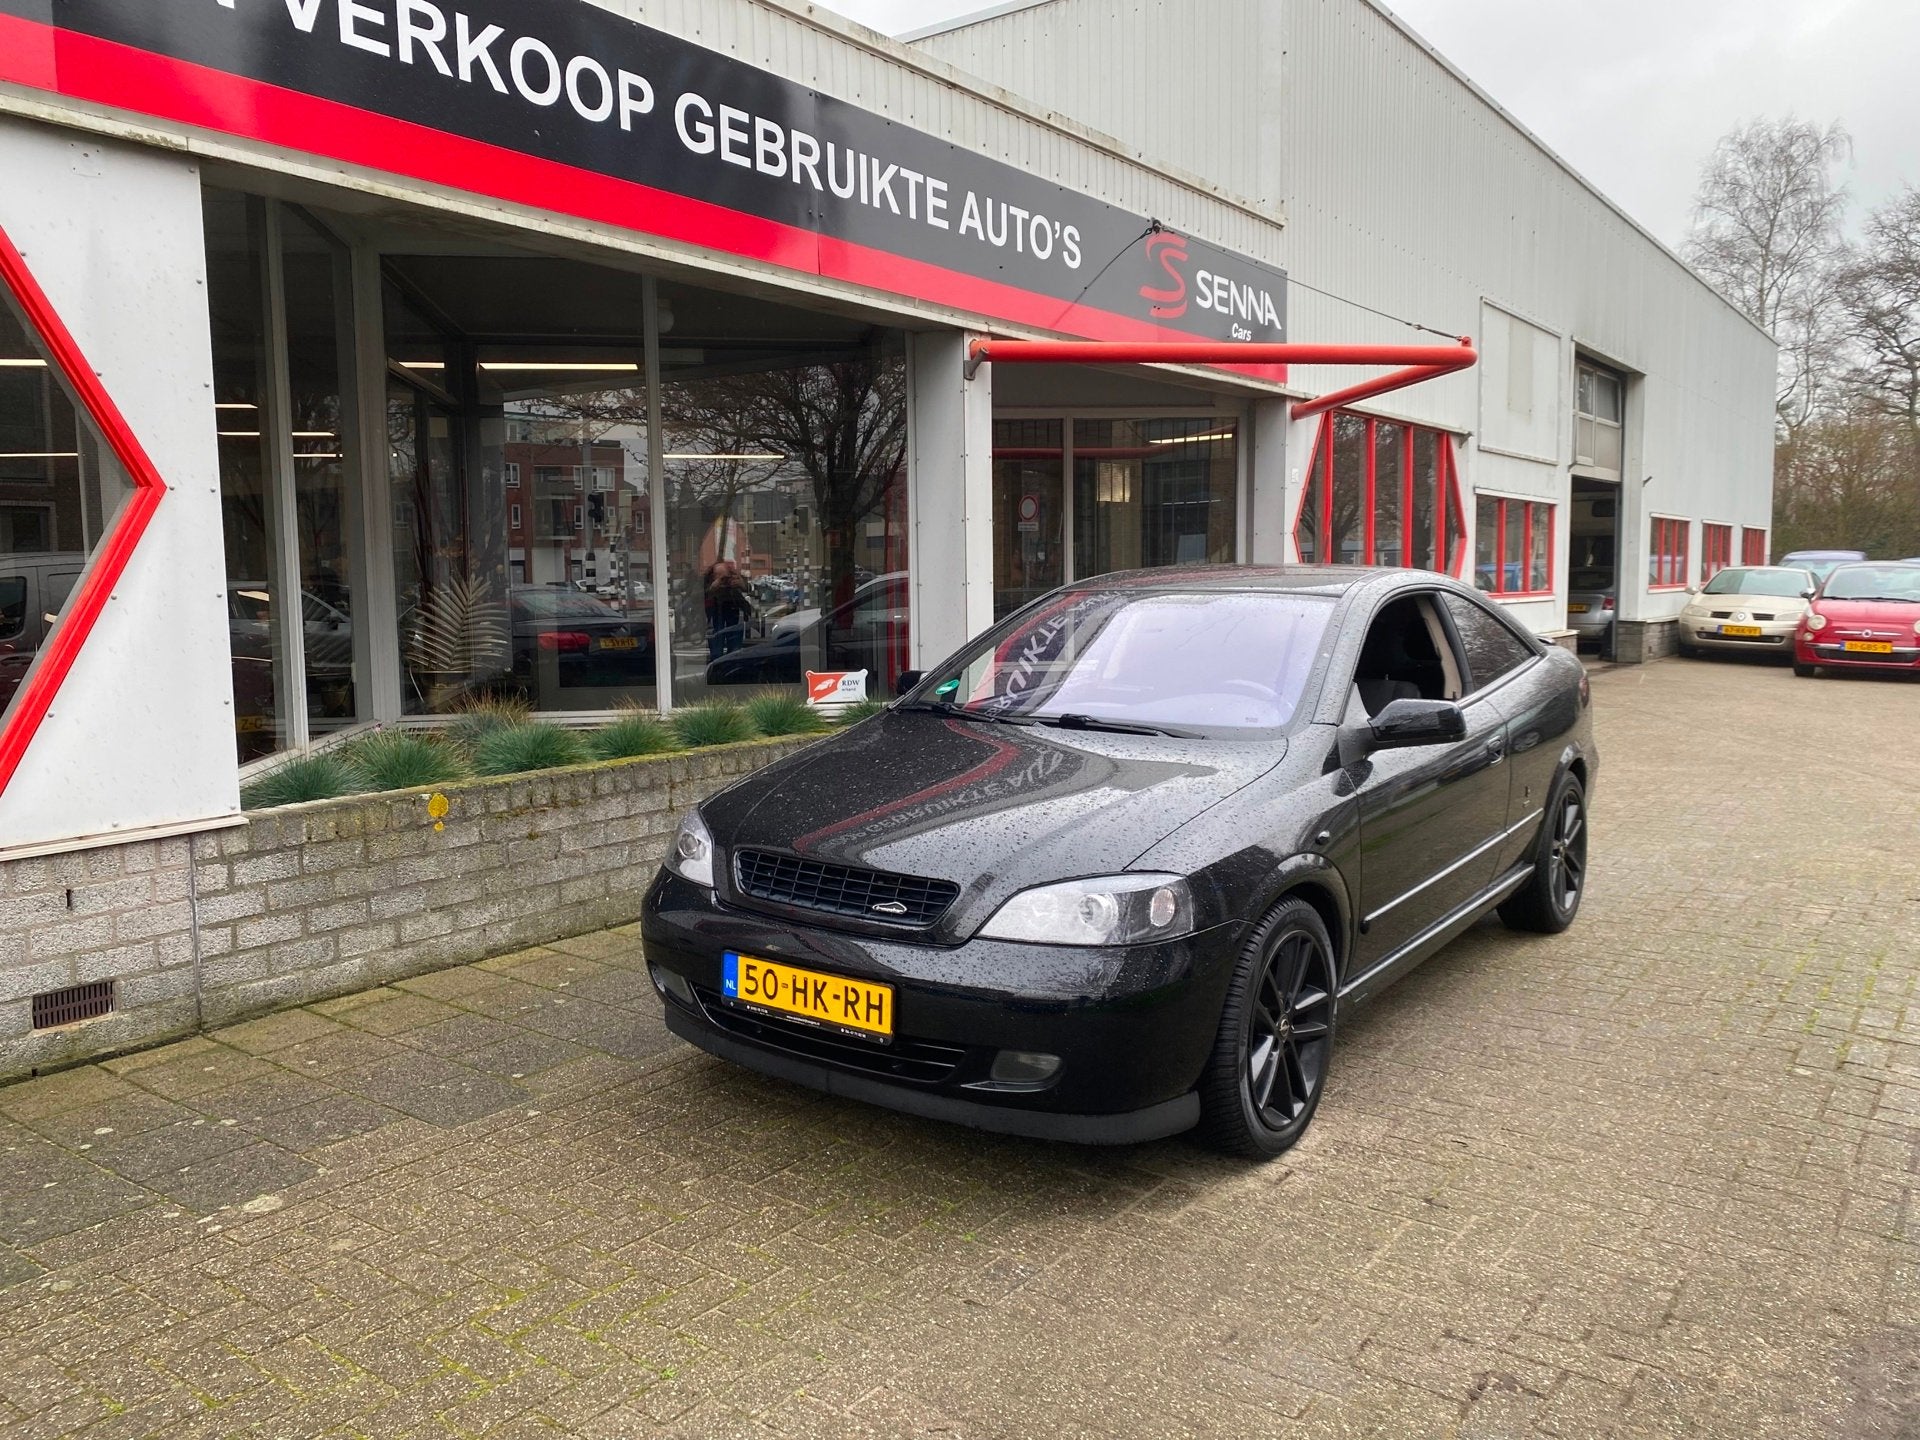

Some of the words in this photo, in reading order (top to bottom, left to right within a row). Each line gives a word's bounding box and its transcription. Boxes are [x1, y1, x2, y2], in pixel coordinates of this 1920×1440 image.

[674, 91, 950, 229] GEBRUIKTE
[958, 190, 1083, 270] AUTO'S
[1195, 269, 1283, 330] SENNA
[1231, 322, 1252, 342] Cars
[725, 978, 737, 991] NL
[744, 963, 884, 1026] 50-HK-RH
